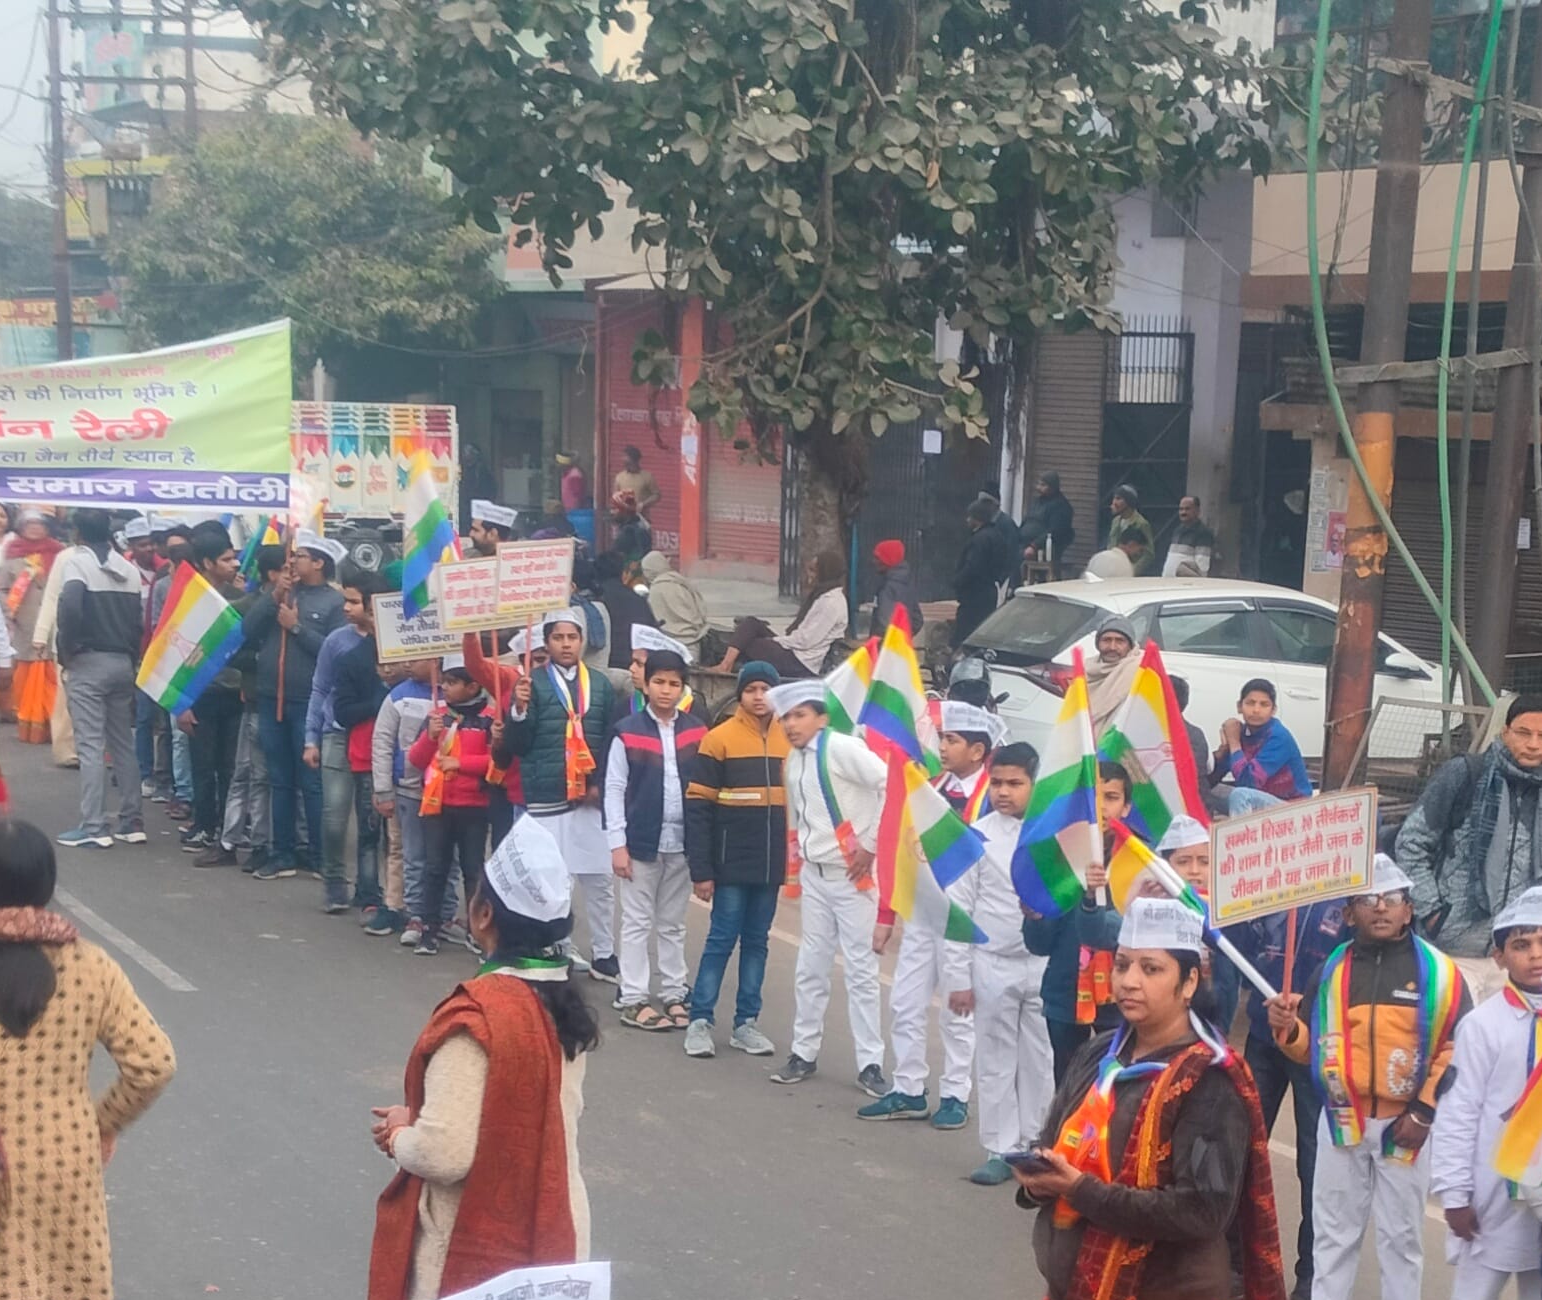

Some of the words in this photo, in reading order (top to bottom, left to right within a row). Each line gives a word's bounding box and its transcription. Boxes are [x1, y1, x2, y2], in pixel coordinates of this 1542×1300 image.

[25, 384, 51, 400] की
[61, 383, 124, 402] निर्वाण
[133, 383, 175, 405] भूमि
[183, 381, 199, 398] है
[70, 407, 174, 443] रैली
[34, 447, 68, 463] जैन
[182, 446, 196, 465] है
[6, 477, 139, 497] समाज
[148, 476, 290, 503] खतौली
[1231, 874, 1264, 901] जीवन
